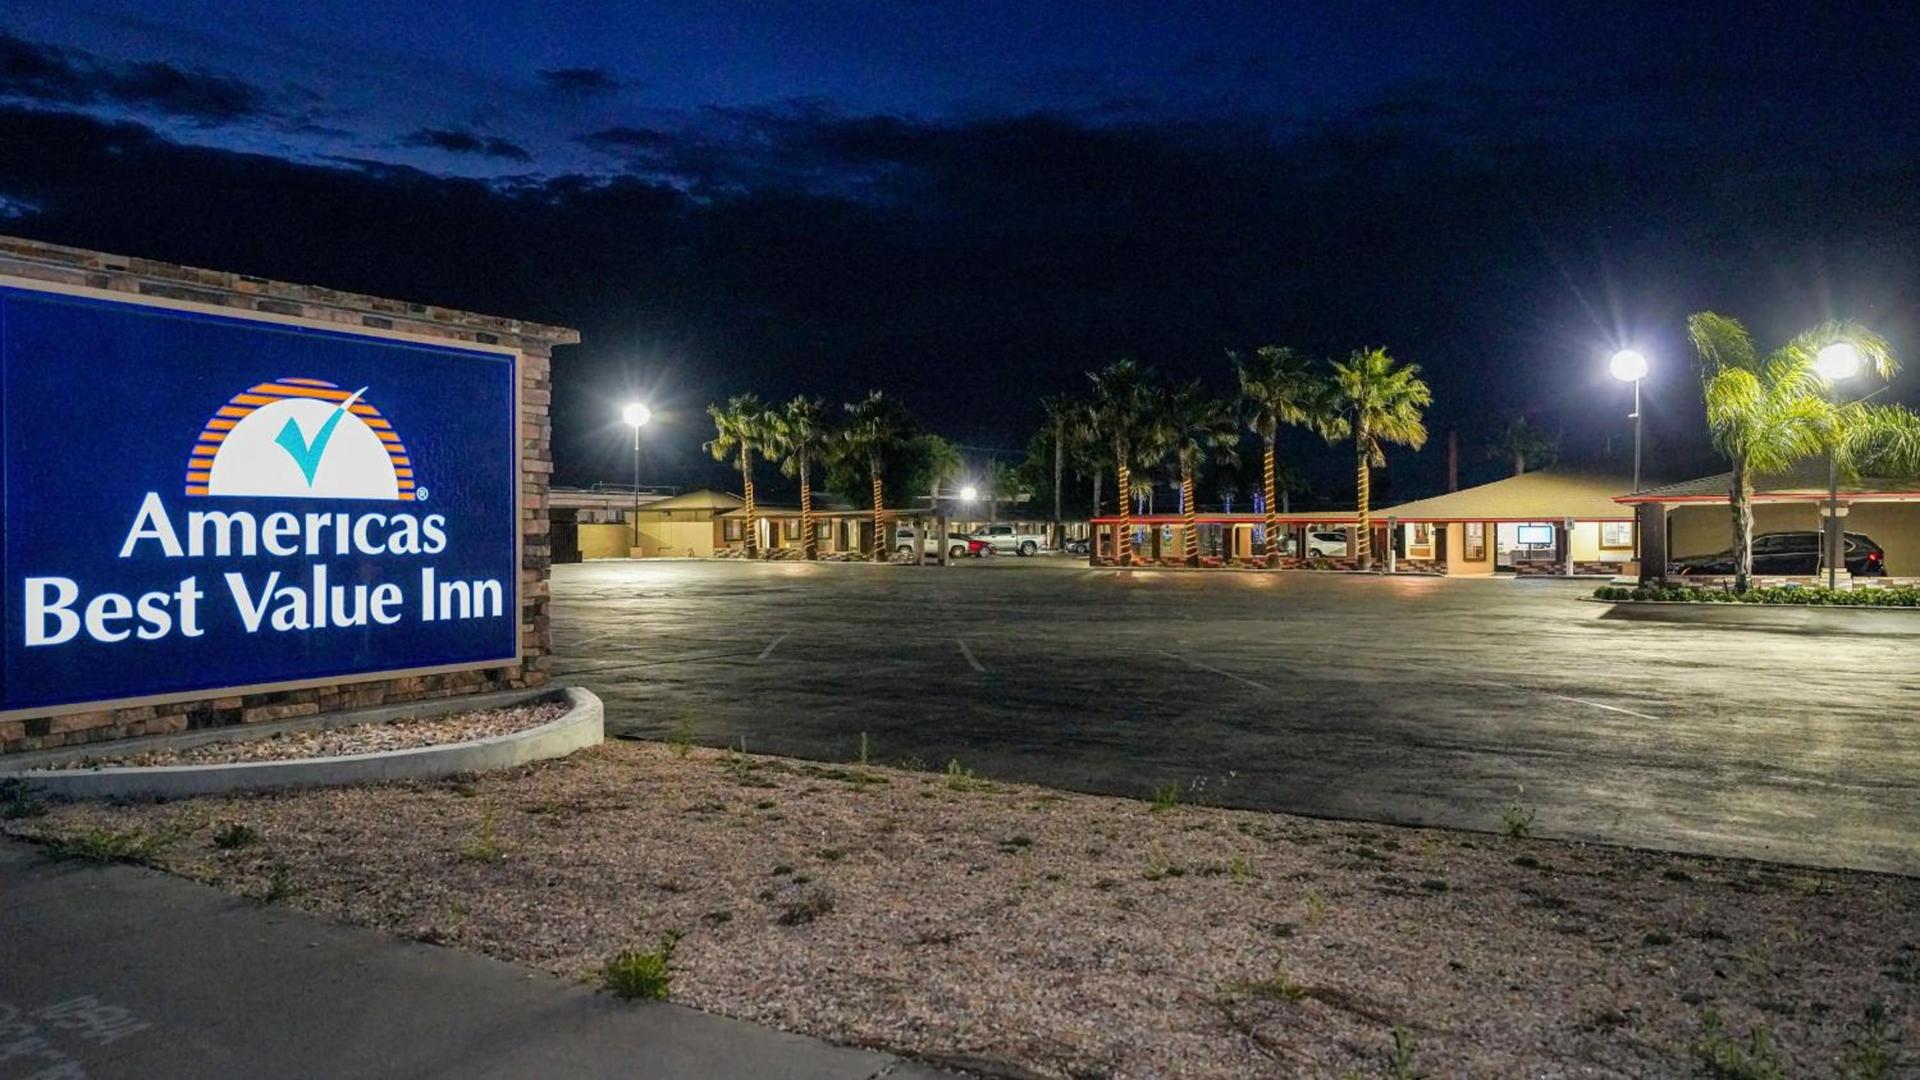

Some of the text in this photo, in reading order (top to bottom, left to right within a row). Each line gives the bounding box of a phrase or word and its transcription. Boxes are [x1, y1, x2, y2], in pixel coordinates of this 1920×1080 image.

[119, 491, 447, 558] Americas
[24, 564, 503, 647] Best Value Inn
